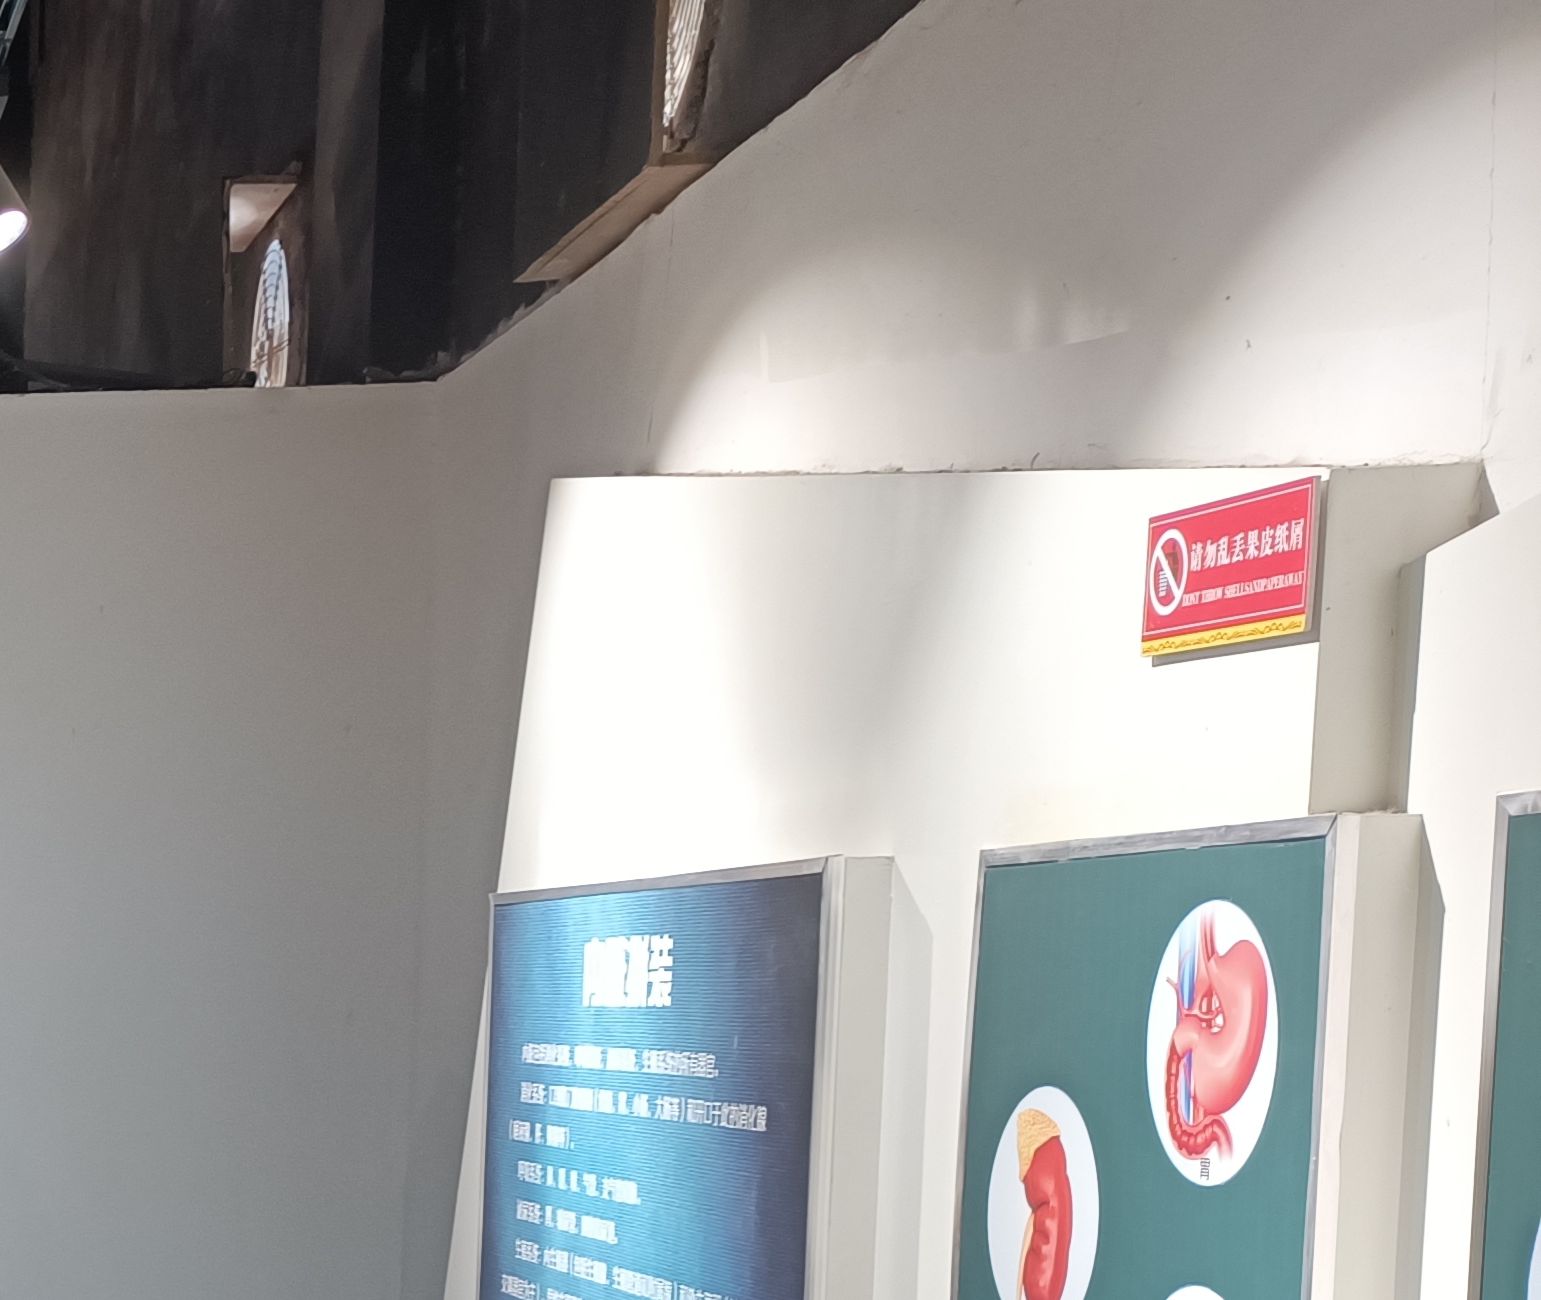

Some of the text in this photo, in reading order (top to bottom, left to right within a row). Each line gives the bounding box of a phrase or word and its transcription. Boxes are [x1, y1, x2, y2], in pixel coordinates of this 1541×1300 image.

[1190, 518, 1305, 572] 请勿乱丢果皮纸屑
[1200, 1157, 1210, 1180] 胃
